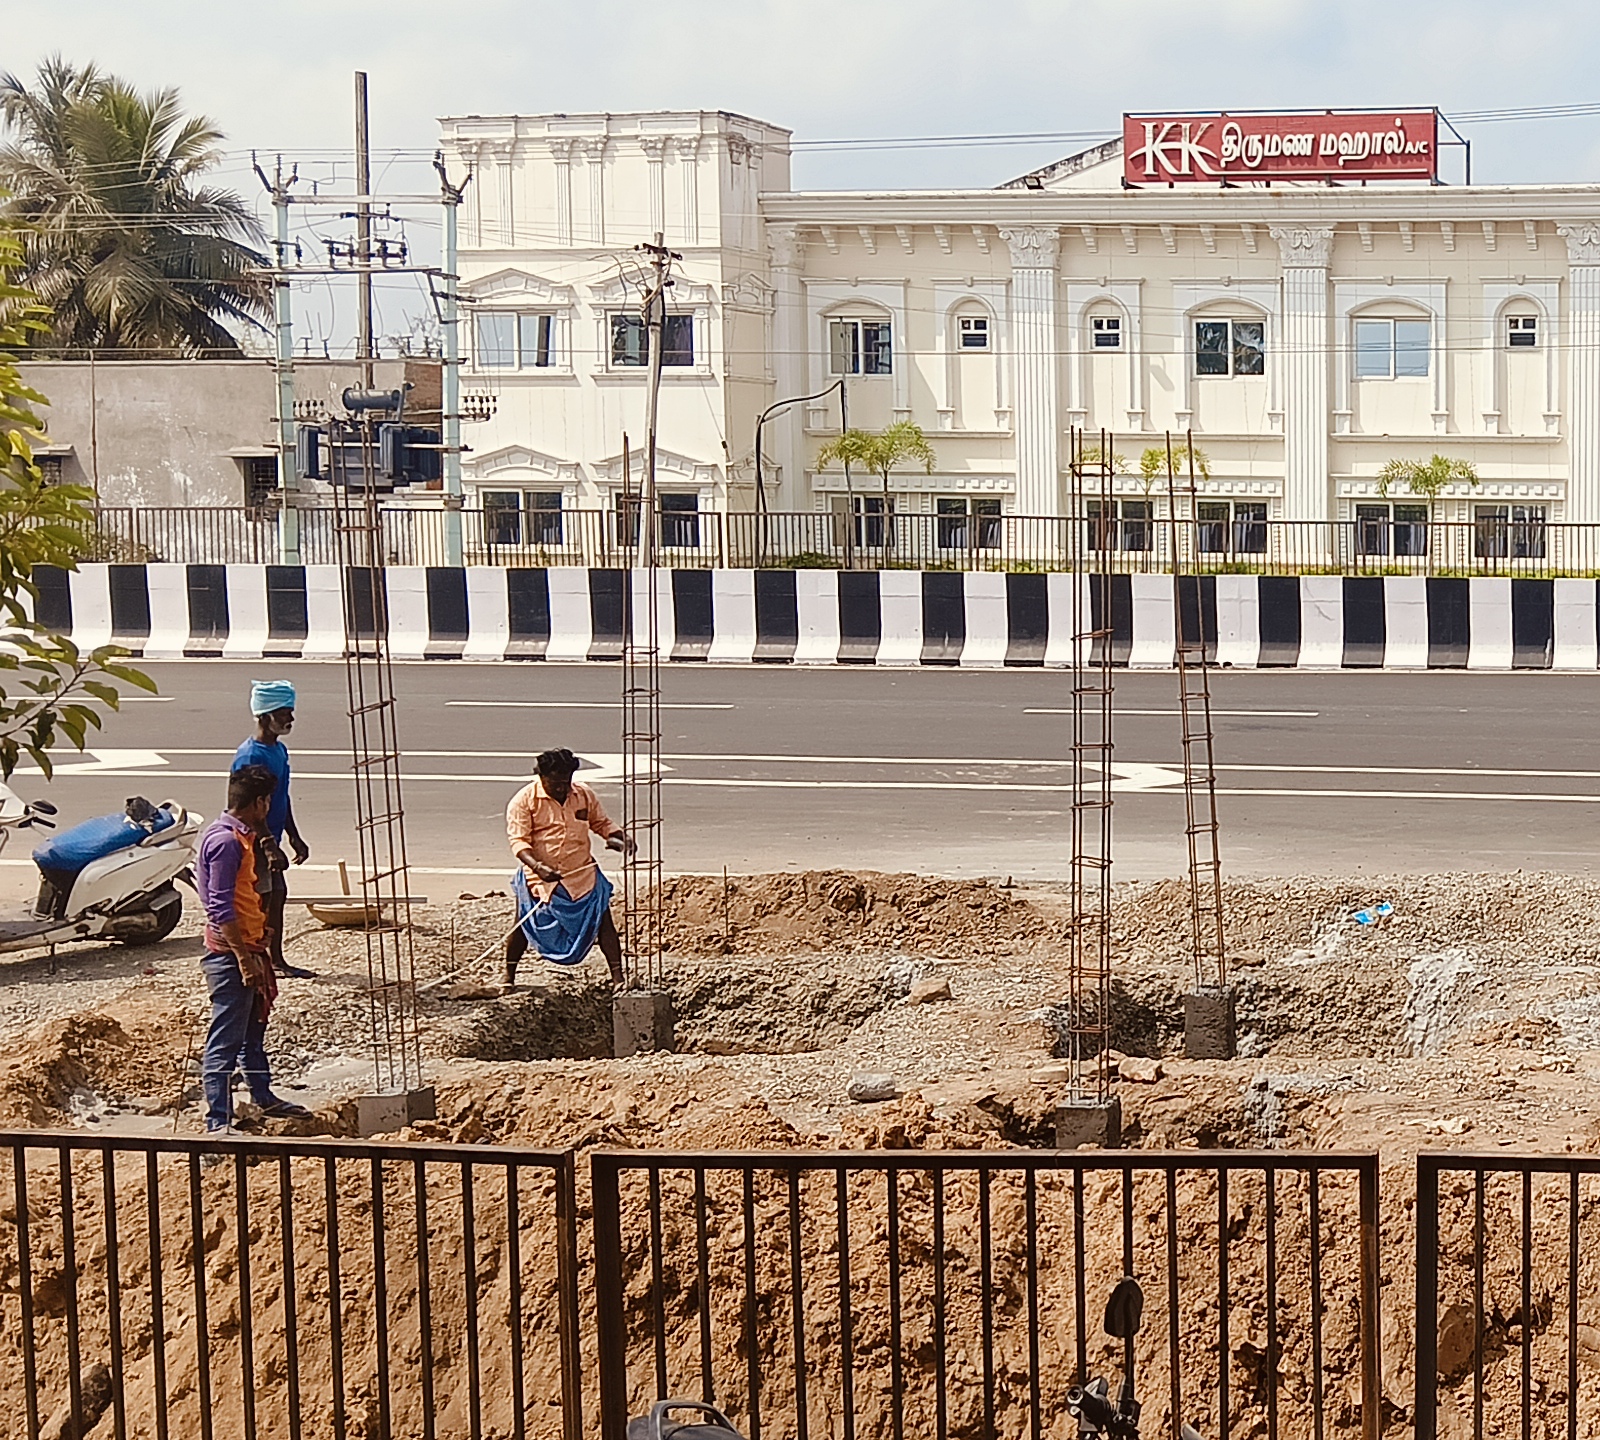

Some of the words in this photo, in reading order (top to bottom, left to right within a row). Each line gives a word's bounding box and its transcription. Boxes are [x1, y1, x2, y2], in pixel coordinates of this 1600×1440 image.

[1130, 122, 1217, 175] KK
[1221, 122, 1315, 168] திருமண
[1319, 118, 1405, 165] மஹால்
[1405, 141, 1428, 154] A/C
